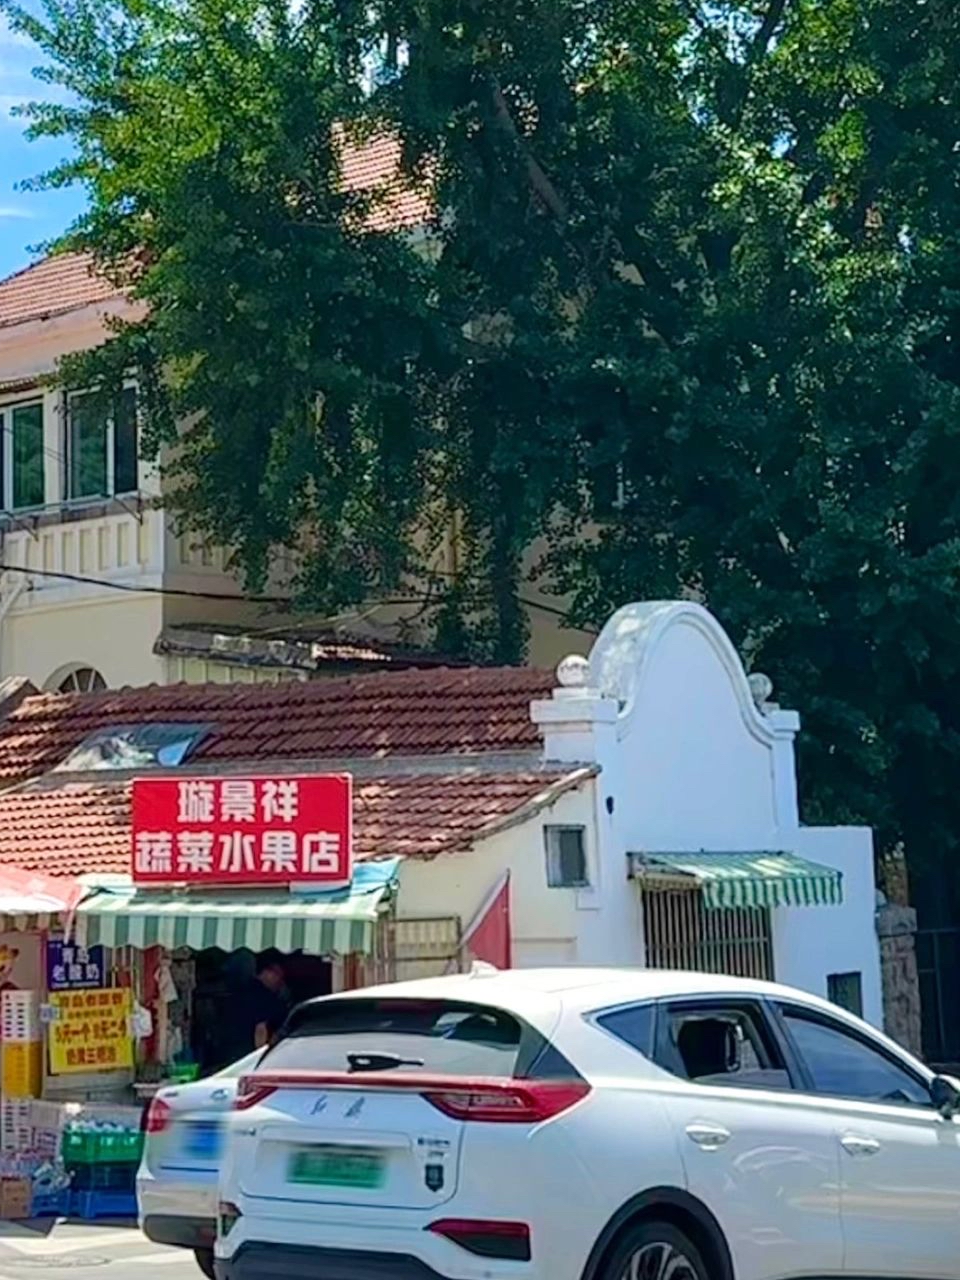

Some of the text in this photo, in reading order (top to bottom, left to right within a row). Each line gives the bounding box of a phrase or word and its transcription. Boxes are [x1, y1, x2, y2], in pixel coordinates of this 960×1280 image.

[135, 830, 340, 873] 蔬菜水果店
[52, 963, 100, 981] 老酸奶
